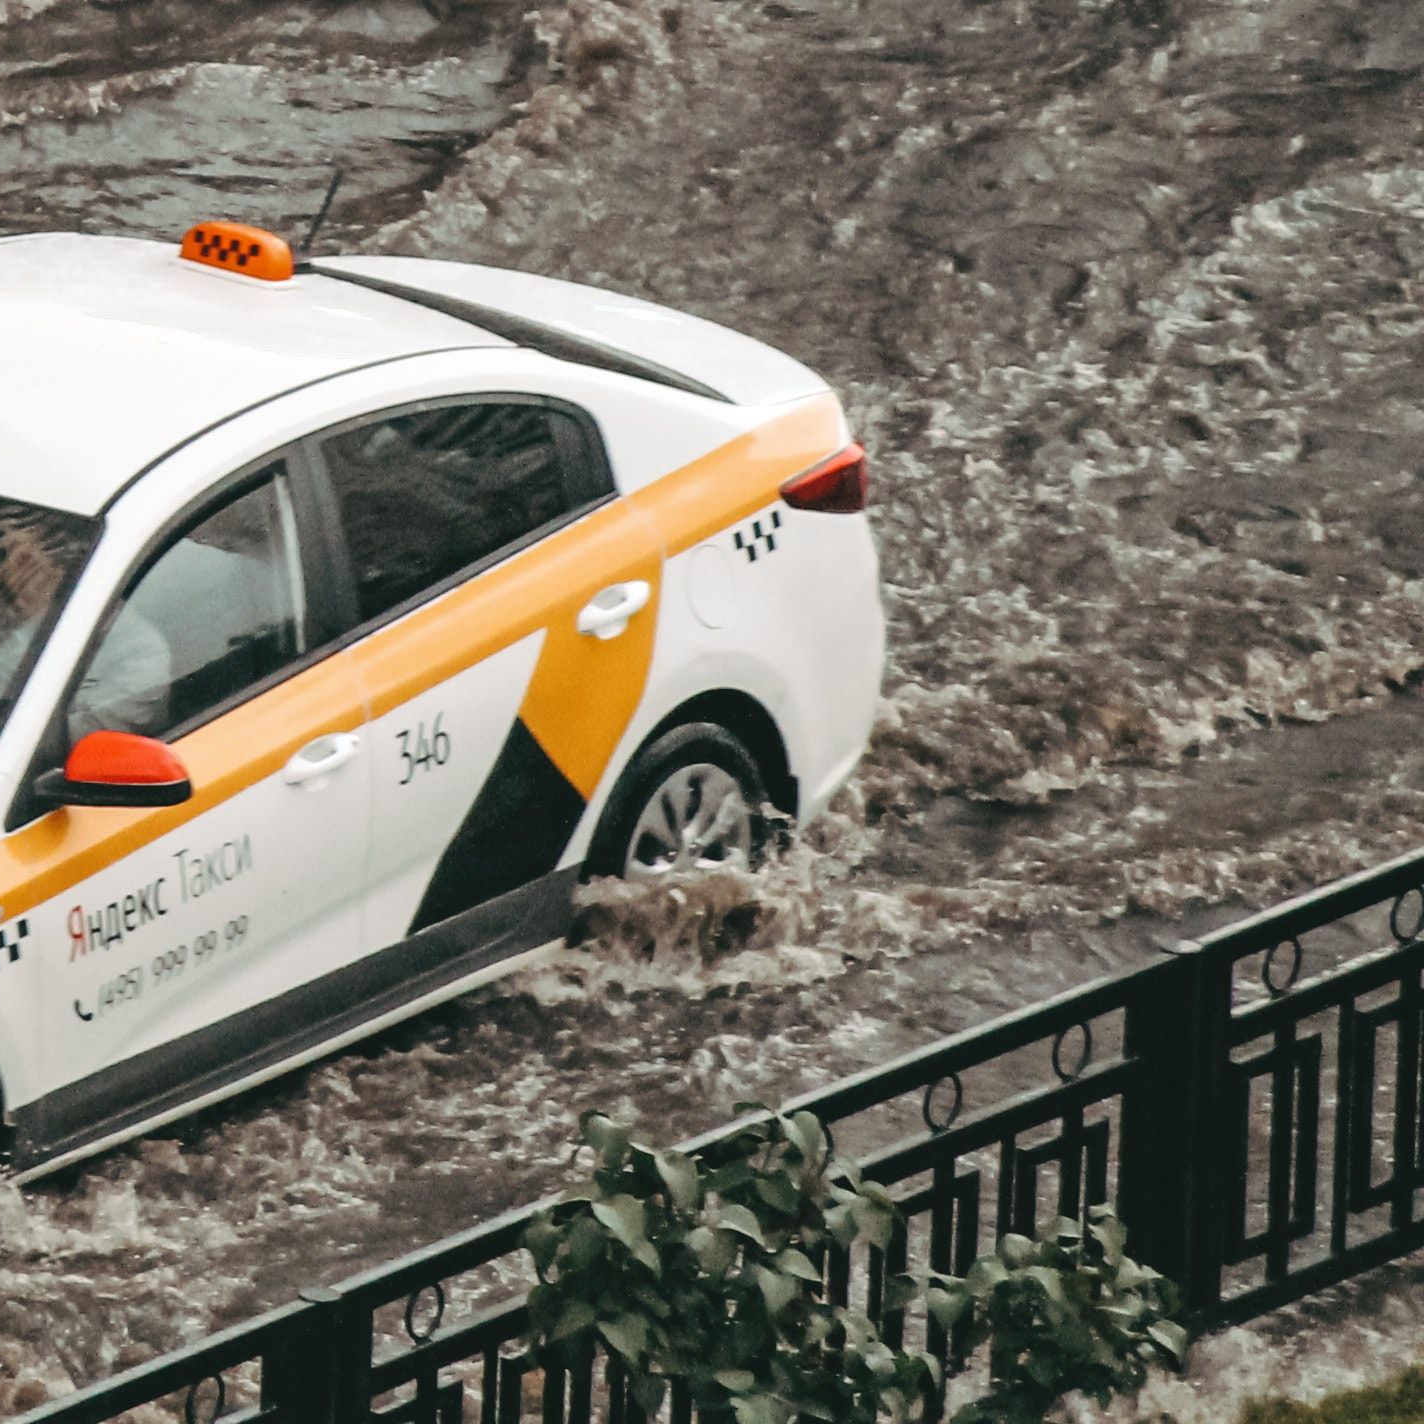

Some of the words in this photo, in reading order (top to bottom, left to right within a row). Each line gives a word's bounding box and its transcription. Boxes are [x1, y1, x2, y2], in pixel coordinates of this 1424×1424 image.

[395, 710, 451, 785] 346
[67, 876, 168, 963] Яндекс
[172, 833, 252, 903] Такси
[98, 965, 144, 1017] (495)
[152, 944, 188, 986] 999
[193, 930, 218, 967] 99
[224, 914, 249, 953] 99
